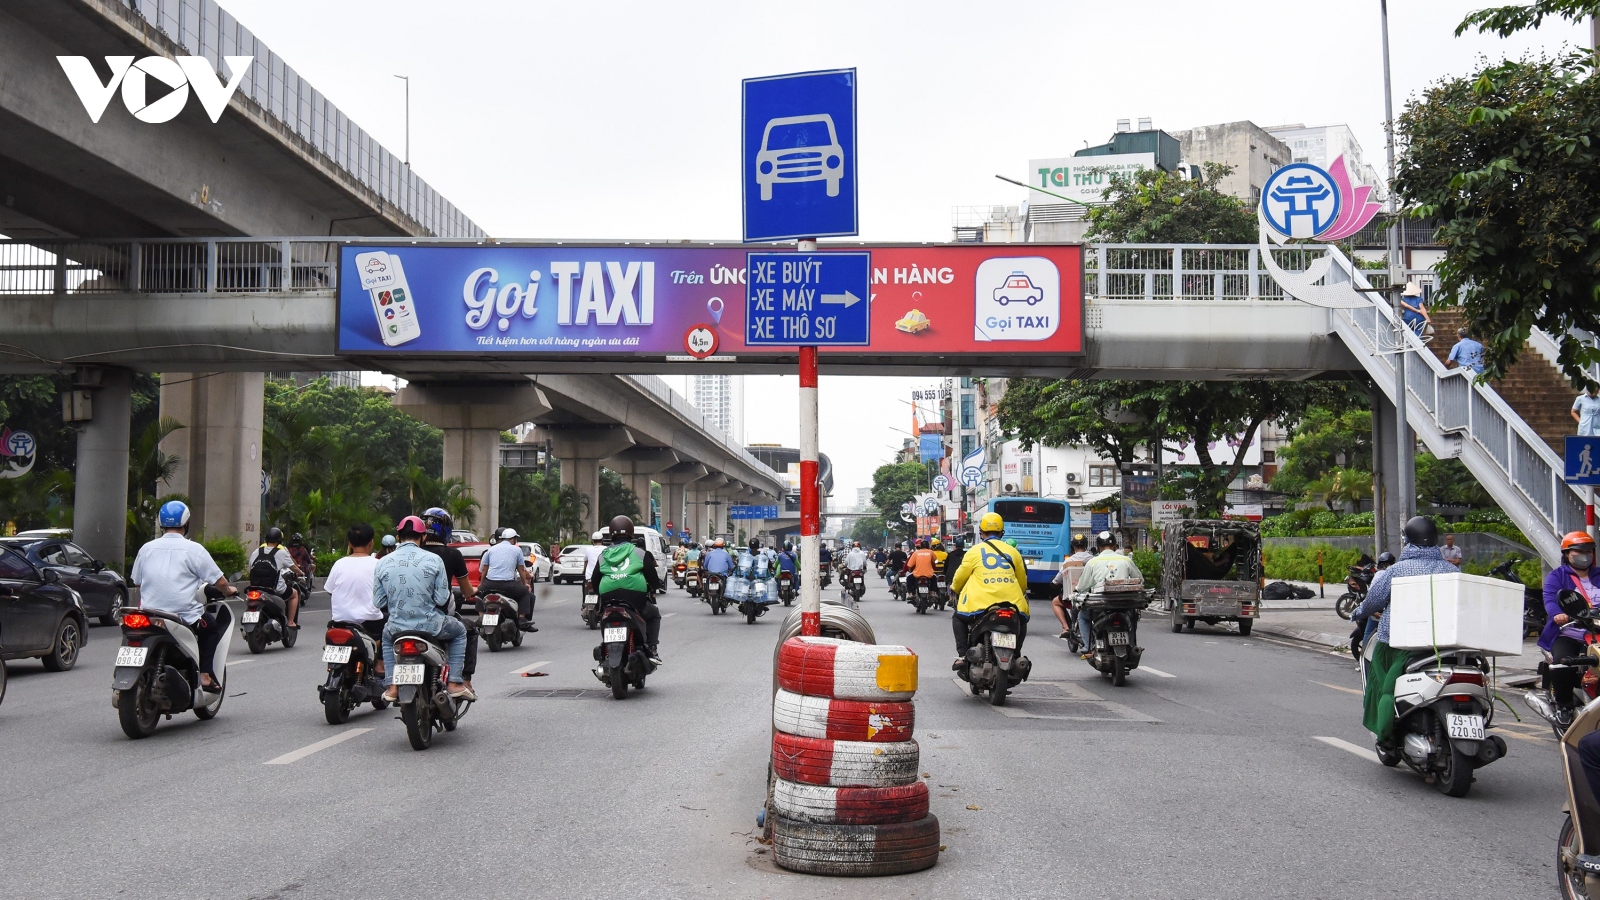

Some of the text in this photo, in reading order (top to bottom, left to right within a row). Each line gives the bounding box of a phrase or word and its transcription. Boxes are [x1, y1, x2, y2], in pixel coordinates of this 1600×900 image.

[1038, 167, 1069, 188] TCI
[670, 270, 704, 284] Trên
[870, 268, 888, 284] N
[894, 263, 954, 284] HÀNG
[752, 257, 822, 284] -XE BUÝT
[463, 261, 655, 331] Gọi TAXI
[751, 284, 816, 311] -XE MÁY
[751, 312, 837, 339] -XE THÔ SƠ
[985, 316, 1049, 332] Gọi TAXI
[476, 335, 493, 345] Tiết
[495, 336, 518, 347] kiệm
[520, 336, 538, 345] hơn
[554, 336, 580, 347] hàng
[581, 337, 607, 347] ngàn
[623, 337, 640, 345] đãi
[692, 335, 709, 347] 4,5m
[925, 389, 936, 400] 555
[1162, 502, 1172, 510] LỐI
[980, 547, 1013, 570] be
[394, 674, 422, 683] 502.80
[1452, 715, 1479, 727] 29-T1
[1450, 726, 1484, 739] 220.90
